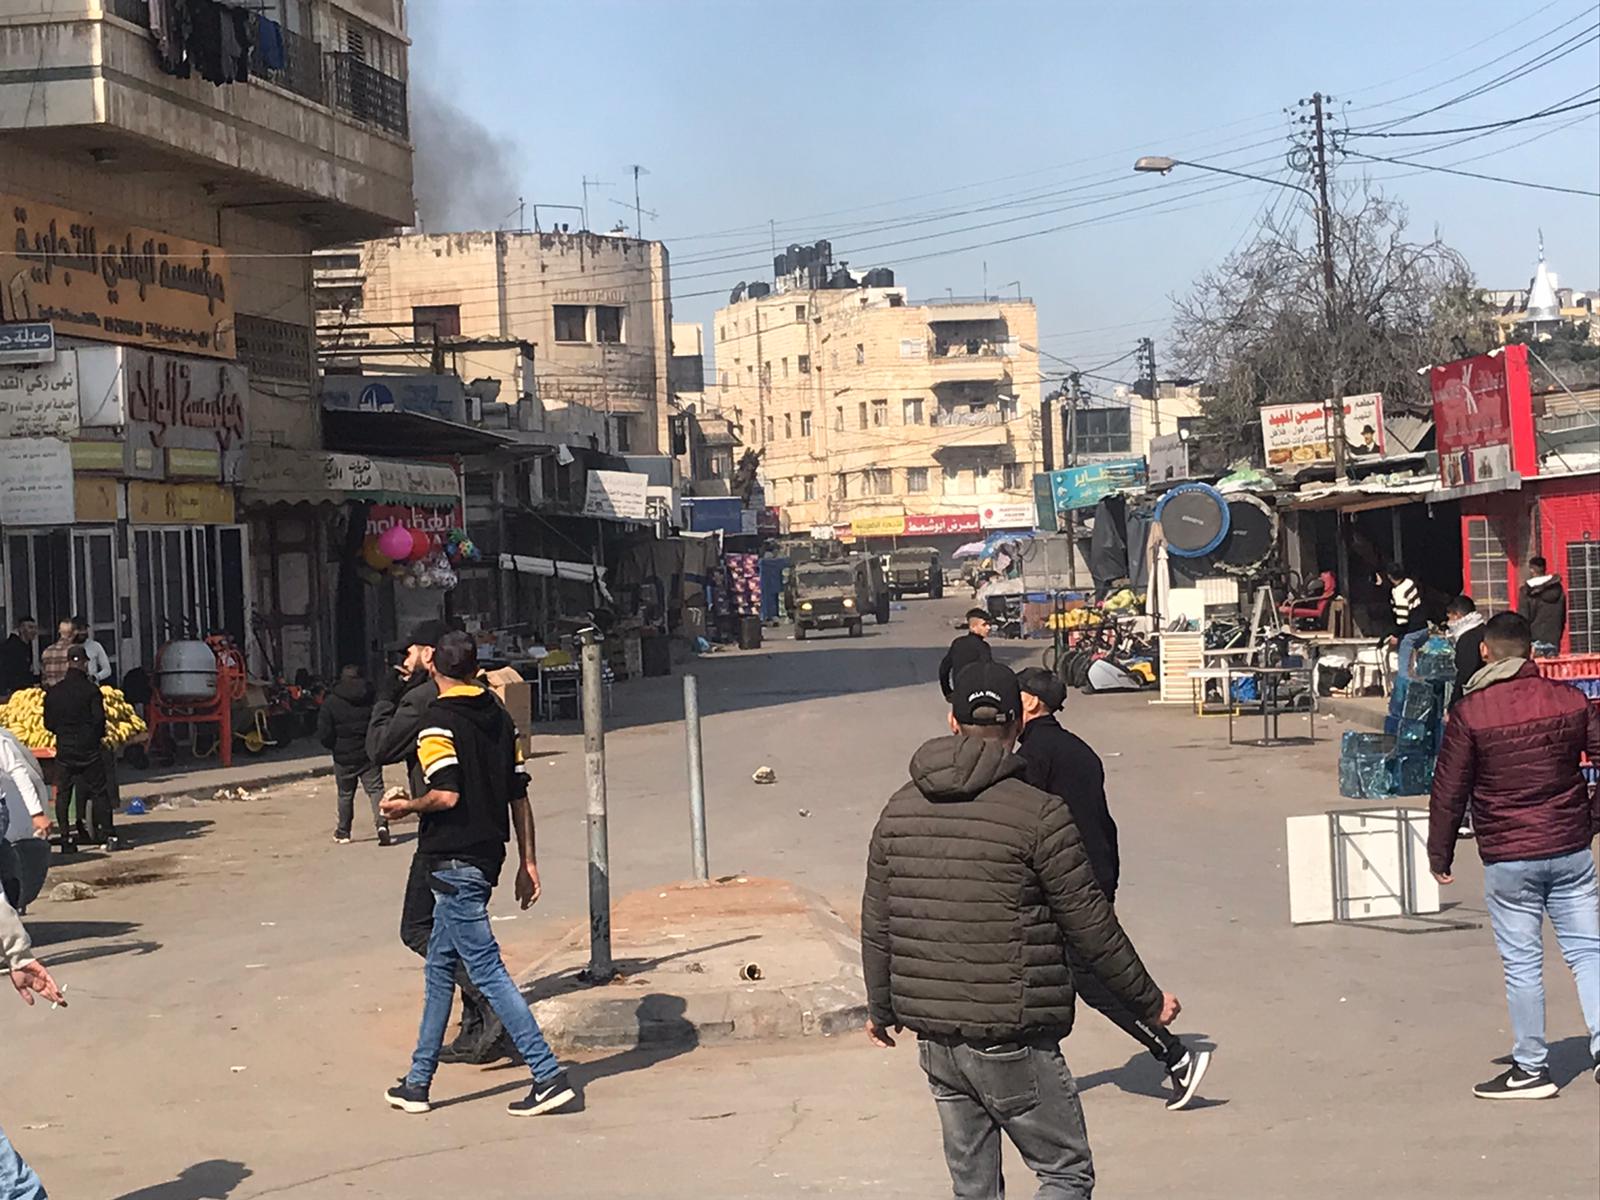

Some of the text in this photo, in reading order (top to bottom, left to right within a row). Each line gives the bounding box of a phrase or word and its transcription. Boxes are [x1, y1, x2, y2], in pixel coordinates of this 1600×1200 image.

[15, 206, 97, 286] التجارية
[158, 243, 225, 316] مؤسسة
[14, 327, 49, 347] صيدلية
[26, 374, 49, 396] زكي
[947, 518, 978, 533] معرض
